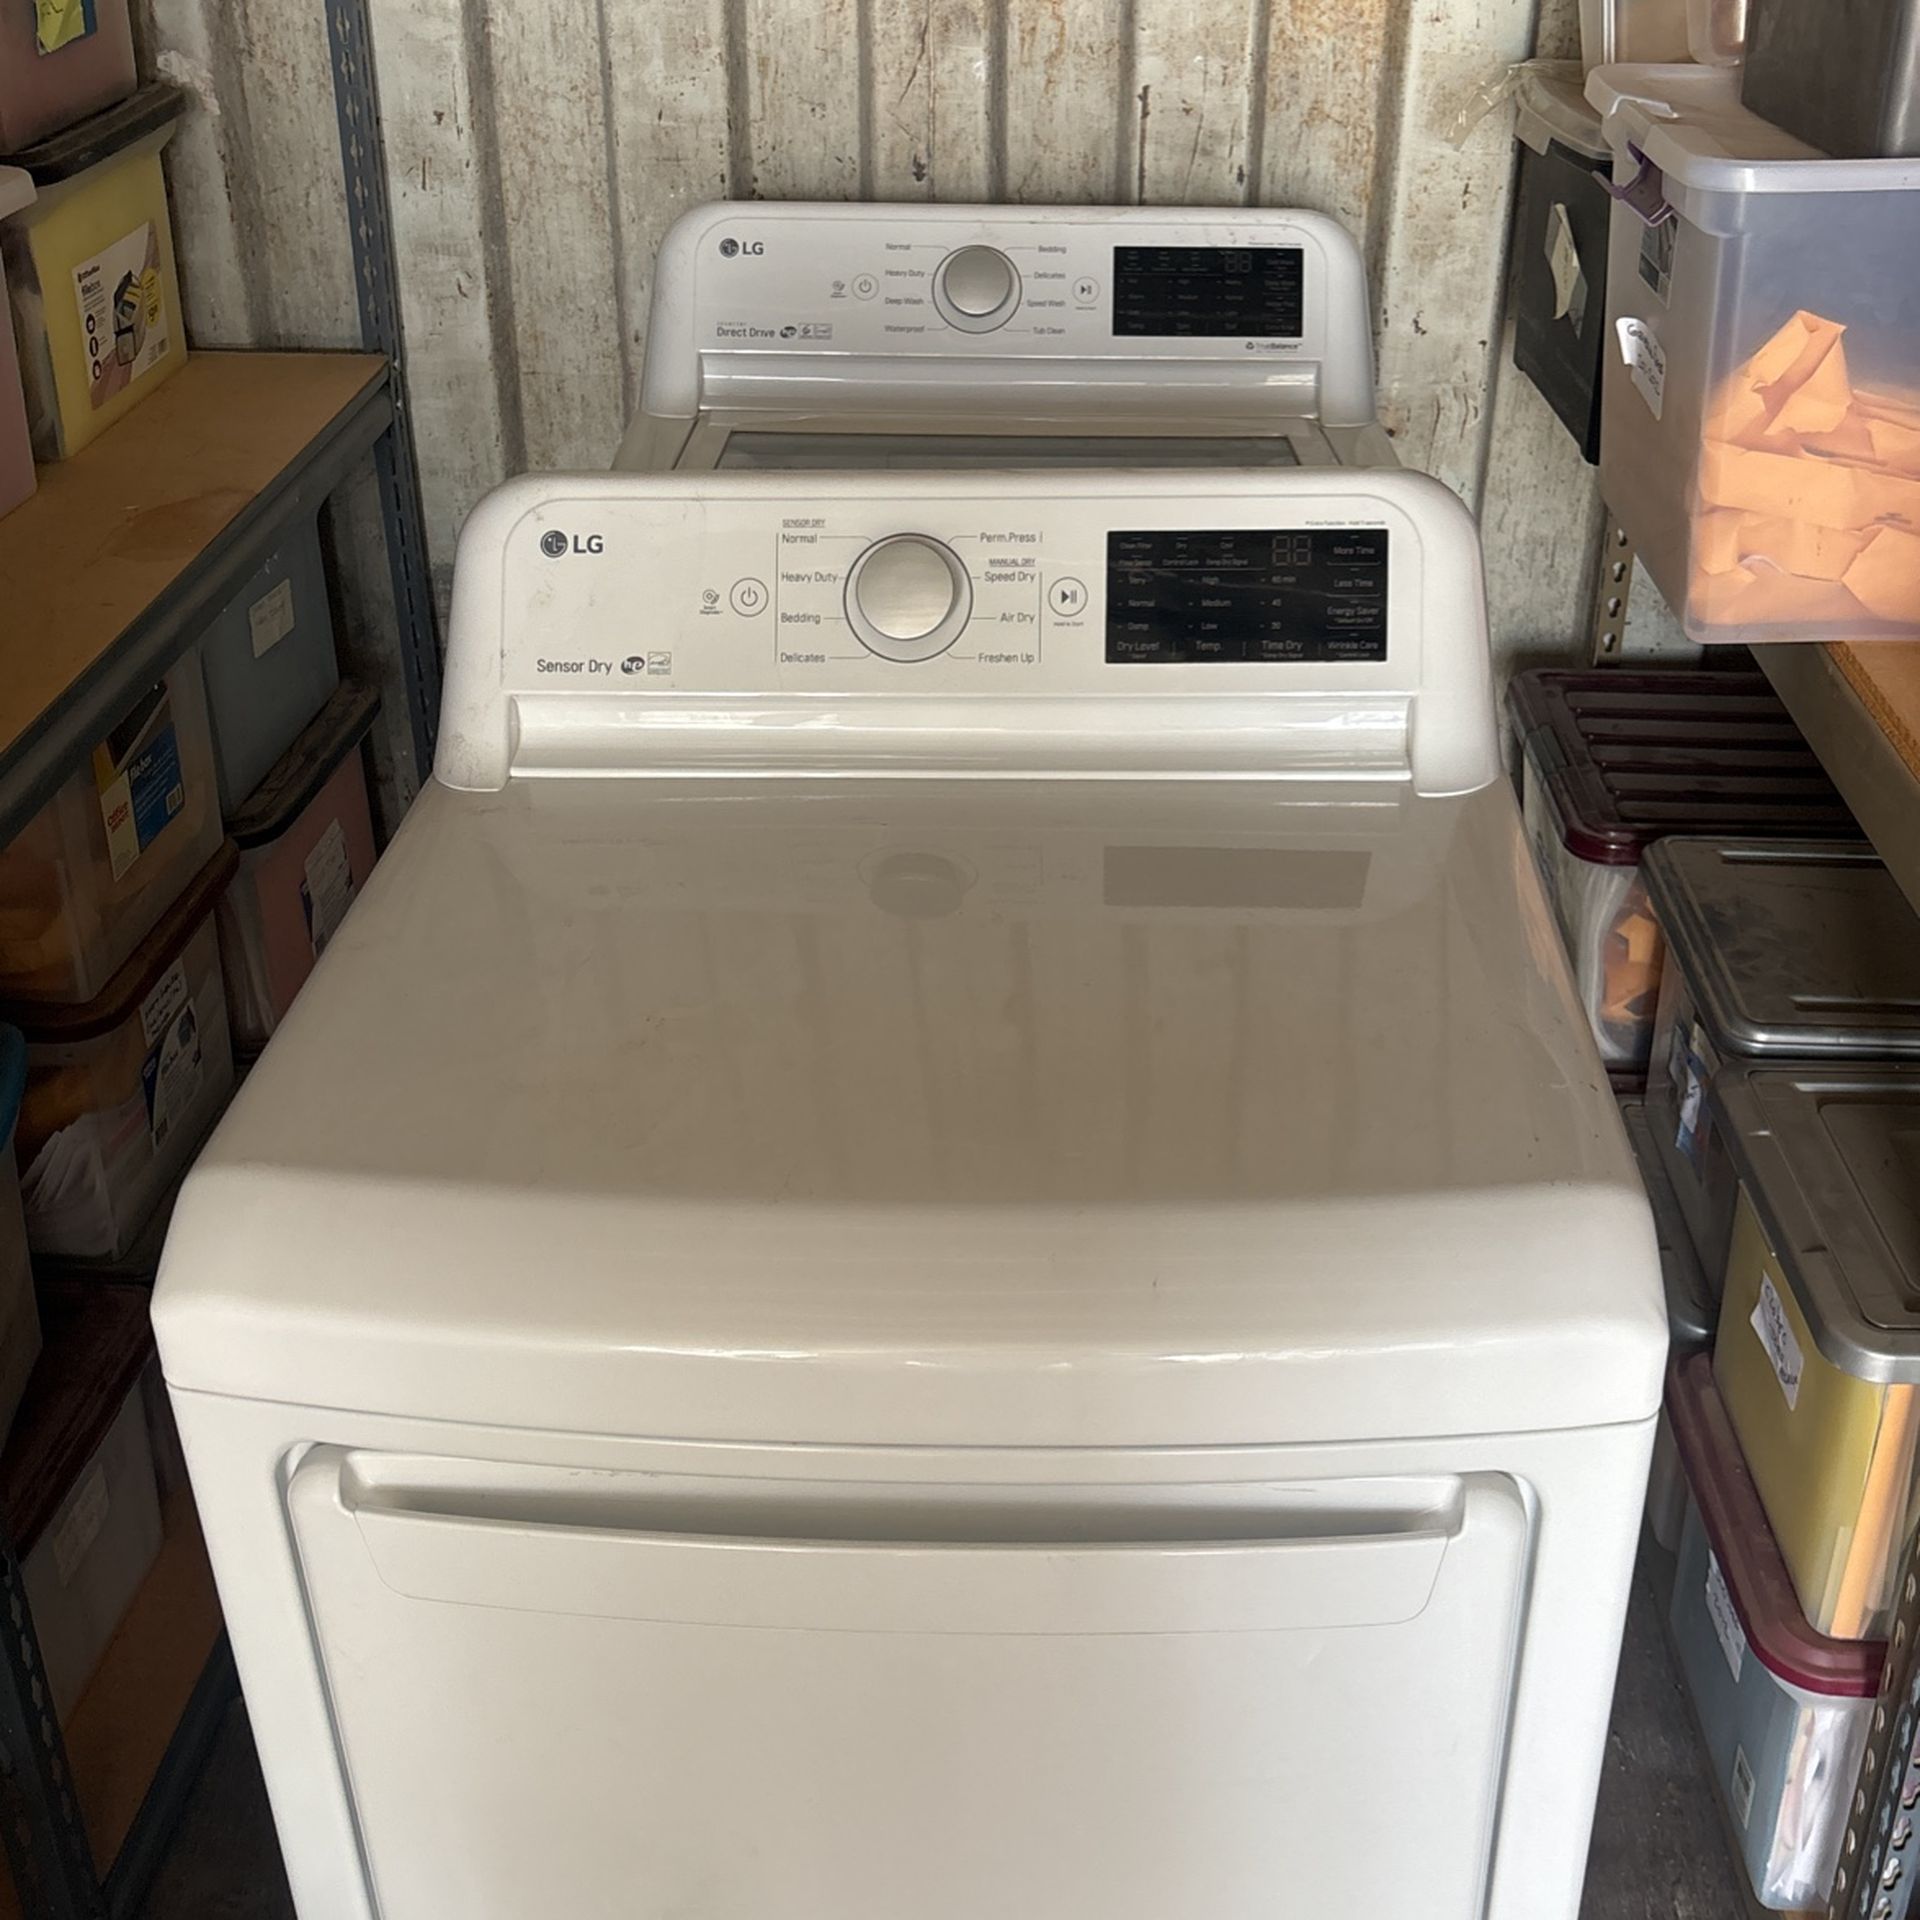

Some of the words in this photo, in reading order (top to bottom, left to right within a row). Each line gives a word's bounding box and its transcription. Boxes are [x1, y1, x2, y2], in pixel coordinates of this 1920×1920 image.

[742, 241, 764, 256] LG
[1038, 245, 1067, 254] Bedding
[908, 269, 926, 278] Duty
[1033, 271, 1066, 279] Delicates
[1026, 299, 1047, 307] Speed
[1048, 299, 1066, 307] Wash
[716, 327, 747, 338] Direct
[749, 327, 776, 338] Drive
[884, 325, 925, 333] Waterproof
[1032, 326, 1046, 334] Tub
[1046, 326, 1066, 334] Clean
[782, 518, 811, 528] SENSOR
[811, 518, 826, 528] DRY
[781, 533, 818, 543] Normal
[980, 532, 1037, 543] Perm.Press
[573, 534, 604, 554] LG
[1333, 546, 1355, 555] More
[1355, 546, 1376, 555] Time
[988, 557, 1020, 566] MANUAL
[1021, 557, 1036, 566] DRY
[781, 572, 812, 584] Heavy
[814, 572, 838, 584] Duty
[984, 572, 1014, 584] Speed
[1015, 572, 1036, 584] Dry
[1333, 579, 1353, 588] Less
[1355, 579, 1374, 588] Time
[1128, 599, 1156, 607] Normal
[1201, 599, 1232, 607] Medium
[1326, 606, 1355, 617] Energy
[1356, 606, 1380, 616] Saver
[780, 613, 821, 625] Bedding
[1000, 613, 1016, 623] Air
[1017, 613, 1036, 625] Dry
[1201, 622, 1218, 630] Low
[1116, 641, 1133, 652] Dry
[1134, 641, 1161, 651] Level
[1261, 640, 1284, 650] Time
[1285, 640, 1304, 652] Dry
[1327, 641, 1358, 650] Wrinkle
[1359, 640, 1379, 650] Care
[780, 653, 826, 663] Delicates
[978, 653, 1019, 663] Freshen
[1020, 653, 1034, 665] Up
[536, 658, 585, 673] Sensor
[588, 658, 613, 676] Dry
